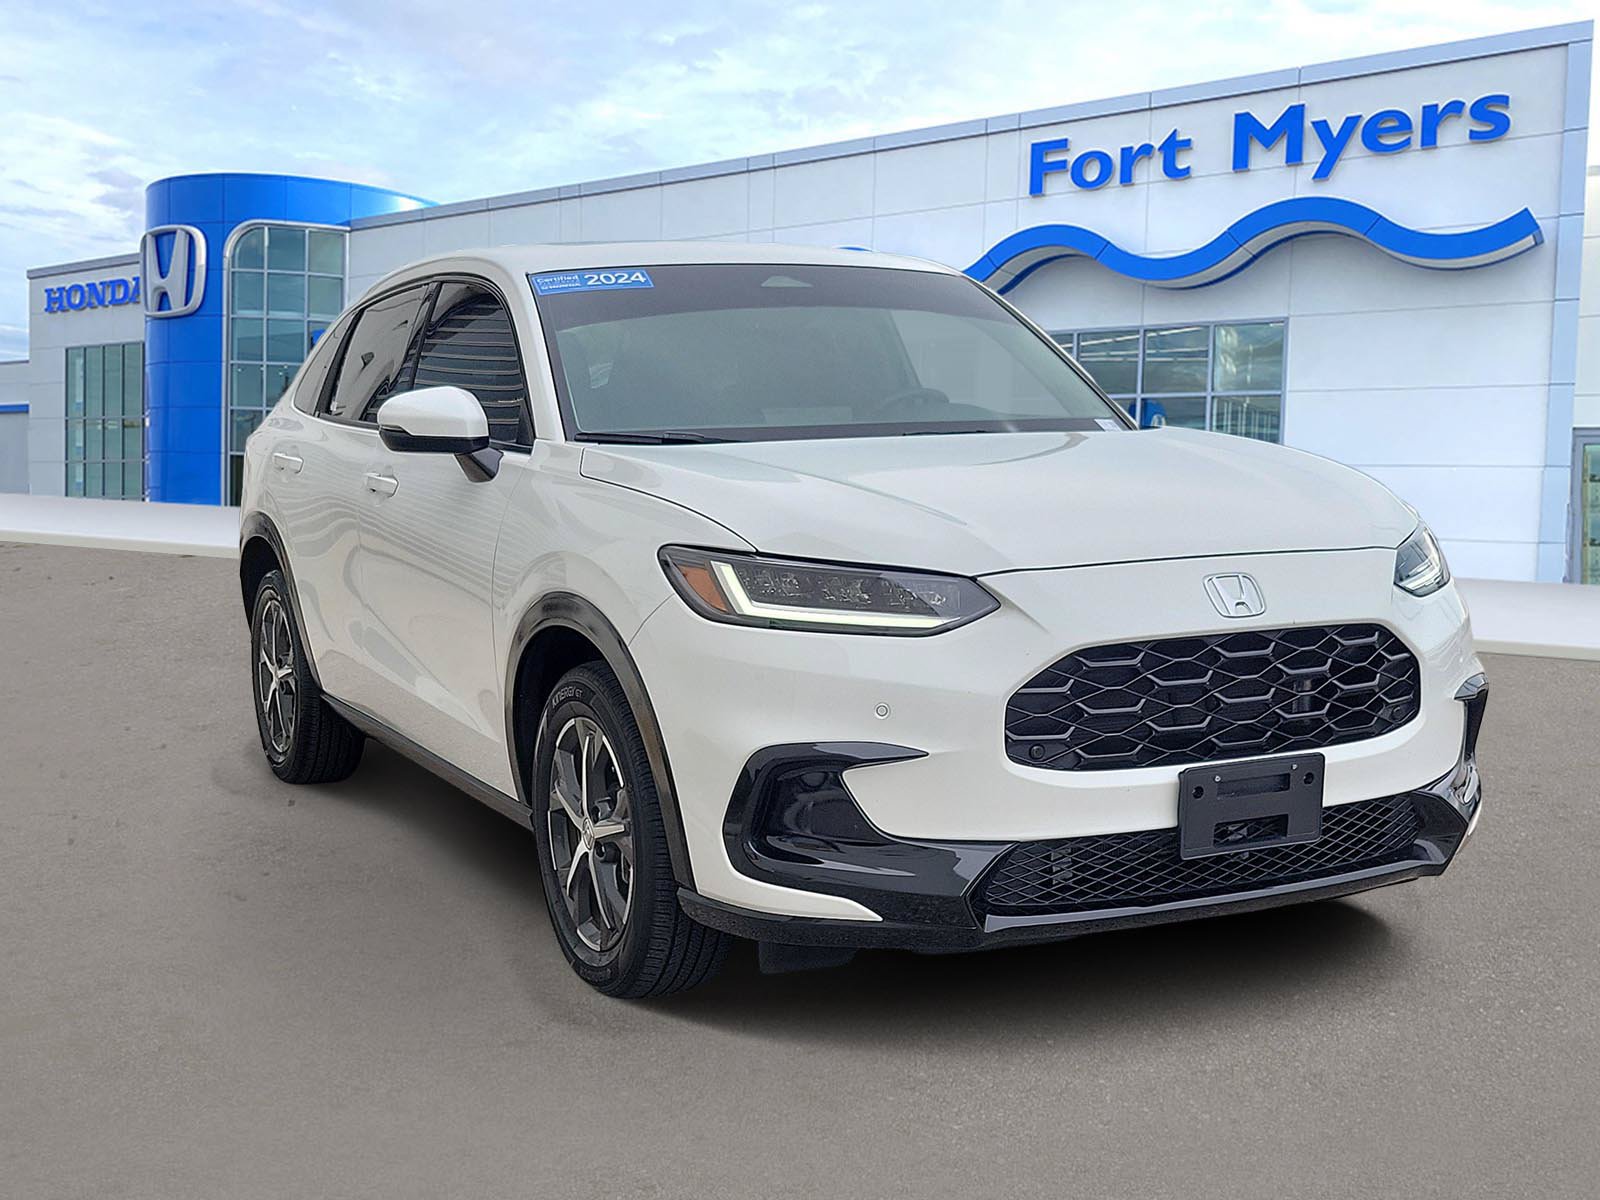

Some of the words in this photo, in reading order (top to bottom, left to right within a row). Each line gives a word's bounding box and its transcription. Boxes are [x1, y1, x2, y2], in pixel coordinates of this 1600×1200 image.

[1029, 129, 1192, 196] Fort
[1232, 94, 1511, 180] Myers
[584, 272, 647, 286] 2024
